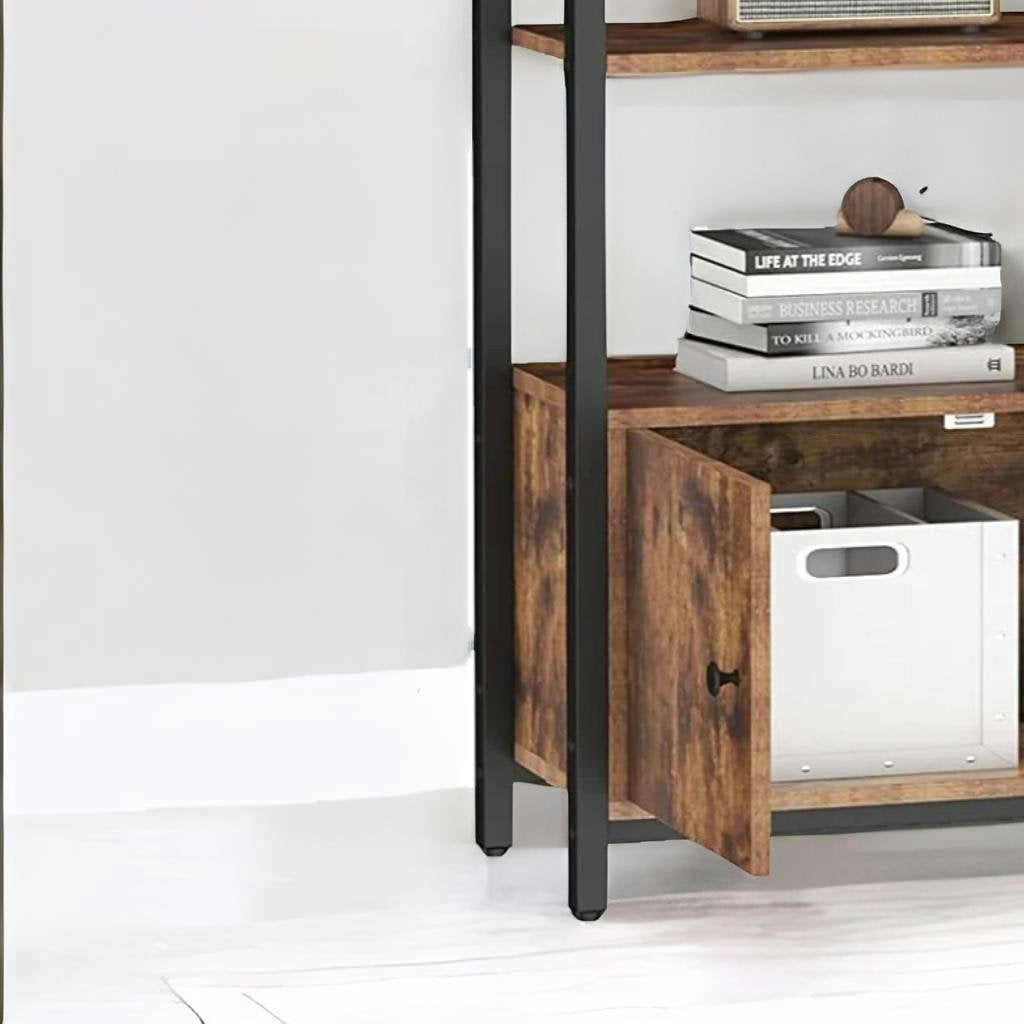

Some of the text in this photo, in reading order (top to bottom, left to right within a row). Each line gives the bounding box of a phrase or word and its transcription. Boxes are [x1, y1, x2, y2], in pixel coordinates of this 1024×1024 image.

[755, 255, 780, 269] LIFE
[783, 255, 799, 269] AT
[801, 254, 826, 267] THE
[828, 252, 862, 266] EDGE
[779, 301, 843, 318] BUSINESS
[846, 297, 917, 315] RESEARCH
[772, 334, 791, 345] TO
[794, 333, 820, 345] KILL
[837, 326, 933, 342] MOCKINGBIRD
[812, 362, 914, 381] LINA BO BARDI
